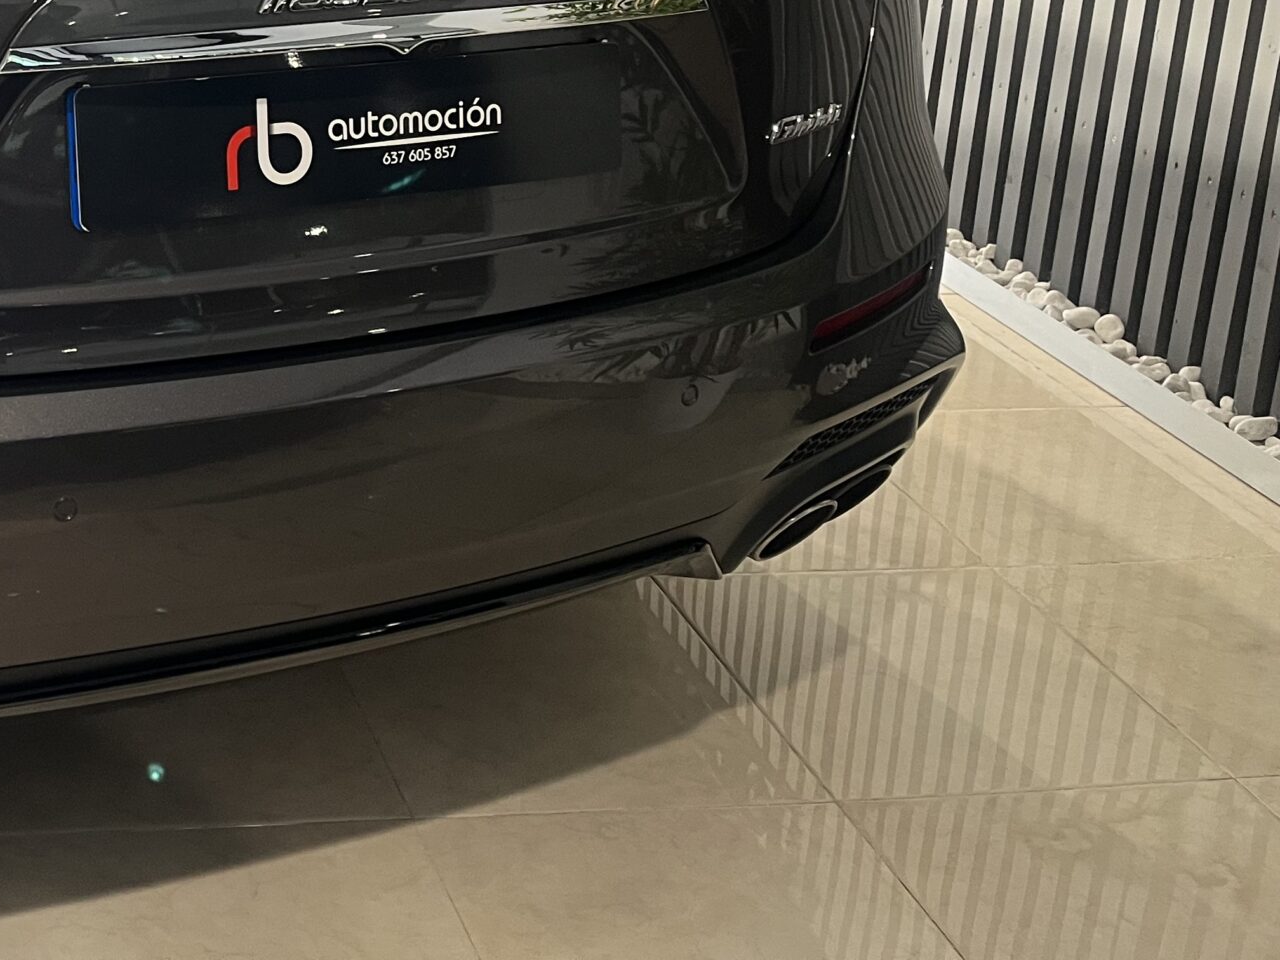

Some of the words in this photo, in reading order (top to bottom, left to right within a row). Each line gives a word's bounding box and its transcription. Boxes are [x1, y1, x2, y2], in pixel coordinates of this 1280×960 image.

[328, 97, 502, 141] automoción
[227, 98, 313, 190] rb
[382, 150, 406, 166] 637
[408, 148, 431, 163] 605
[434, 145, 457, 160] 857
